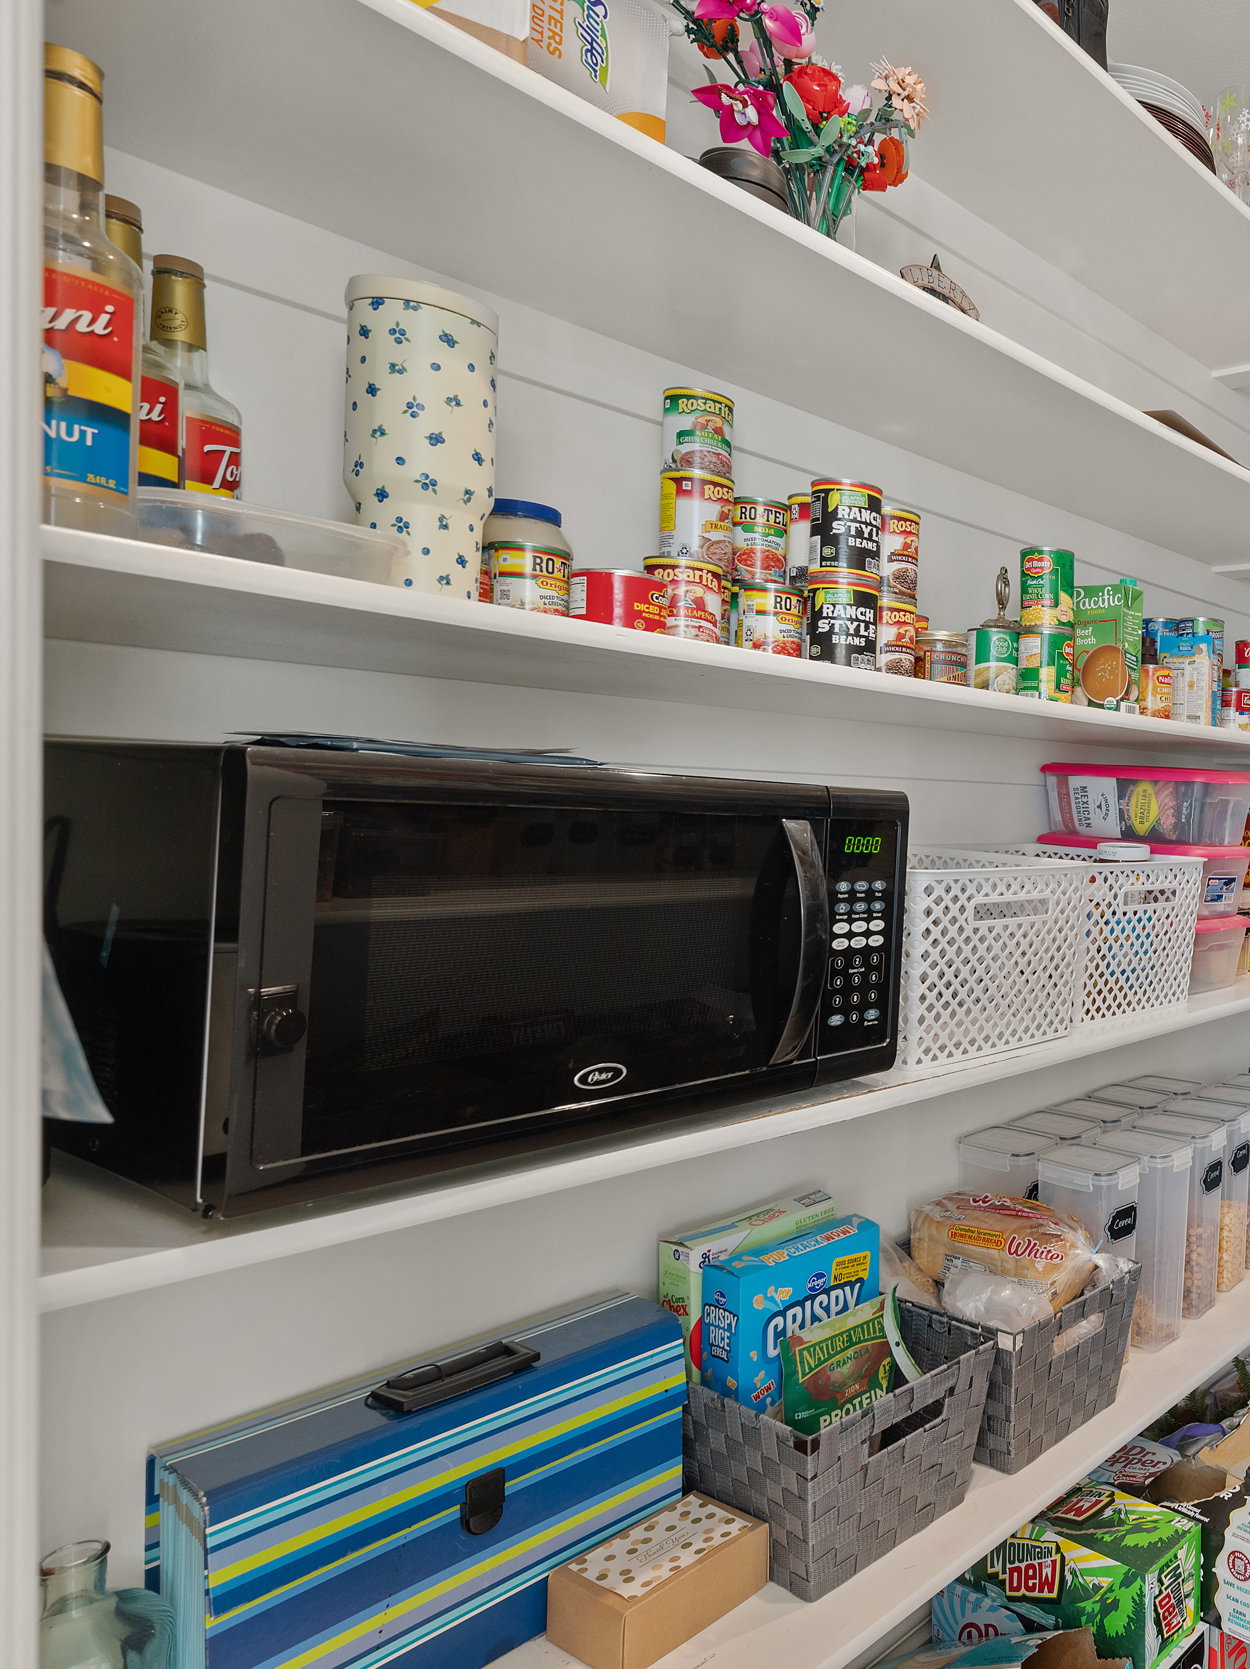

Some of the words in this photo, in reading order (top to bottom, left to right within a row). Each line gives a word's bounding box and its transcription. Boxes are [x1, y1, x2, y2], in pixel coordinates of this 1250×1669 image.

[837, 505, 882, 524] RANCH
[752, 525, 775, 534] Mild
[848, 537, 877, 551] BEANS
[1025, 560, 1033, 568] Del
[1033, 560, 1051, 568] Monte
[654, 568, 719, 593] Rosarita
[1074, 586, 1124, 611] Pacific
[633, 602, 660, 614] DICED
[822, 604, 874, 620] RANCH
[816, 618, 877, 640] STYLE
[1076, 627, 1092, 636] Beef
[832, 634, 866, 647] BEANS
[995, 639, 1008, 648] food
[1076, 636, 1096, 645] Broth
[995, 645, 1007, 653] club
[1073, 787, 1085, 827] SEASONING
[1080, 785, 1092, 829] MEXICAN
[1139, 788, 1147, 825] BRAZILIAN
[587, 1070, 614, 1084] Oster
[1236, 1146, 1248, 1159] Cereal
[1207, 1168, 1220, 1182] Cereal
[794, 1213, 816, 1226] GLUTEN
[816, 1206, 835, 1220] FREE
[1113, 1210, 1135, 1231] Cereal
[761, 1250, 788, 1266] POP
[787, 1236, 823, 1256] CRACK
[821, 1225, 858, 1243] WOW!
[1007, 1235, 1065, 1264] White
[847, 1257, 862, 1265] SOURCE
[807, 1275, 828, 1290] Kroger
[833, 1272, 843, 1283] NO
[671, 1295, 685, 1304] Corn
[714, 1292, 727, 1304] Kroger
[777, 1289, 793, 1300] POP
[661, 1299, 689, 1317] Chex
[704, 1305, 738, 1334] CRISPY
[767, 1283, 862, 1358] CRISPY
[709, 1325, 731, 1350] RICE
[711, 1346, 729, 1362] CEREAL
[801, 1332, 849, 1374] NATURE
[828, 1346, 871, 1373] GRANOLA
[751, 1381, 776, 1404] WOW!
[819, 1383, 888, 1432] PROTEIN
[1124, 1444, 1156, 1458] Dr
[636, 1543, 666, 1562] Thank
[666, 1531, 690, 1546] You
[1223, 1578, 1236, 1589] SAVE
[1226, 1593, 1239, 1605] SCAN
[1228, 1611, 1250, 1625] SUMMER
[1232, 1608, 1247, 1618] EARN
